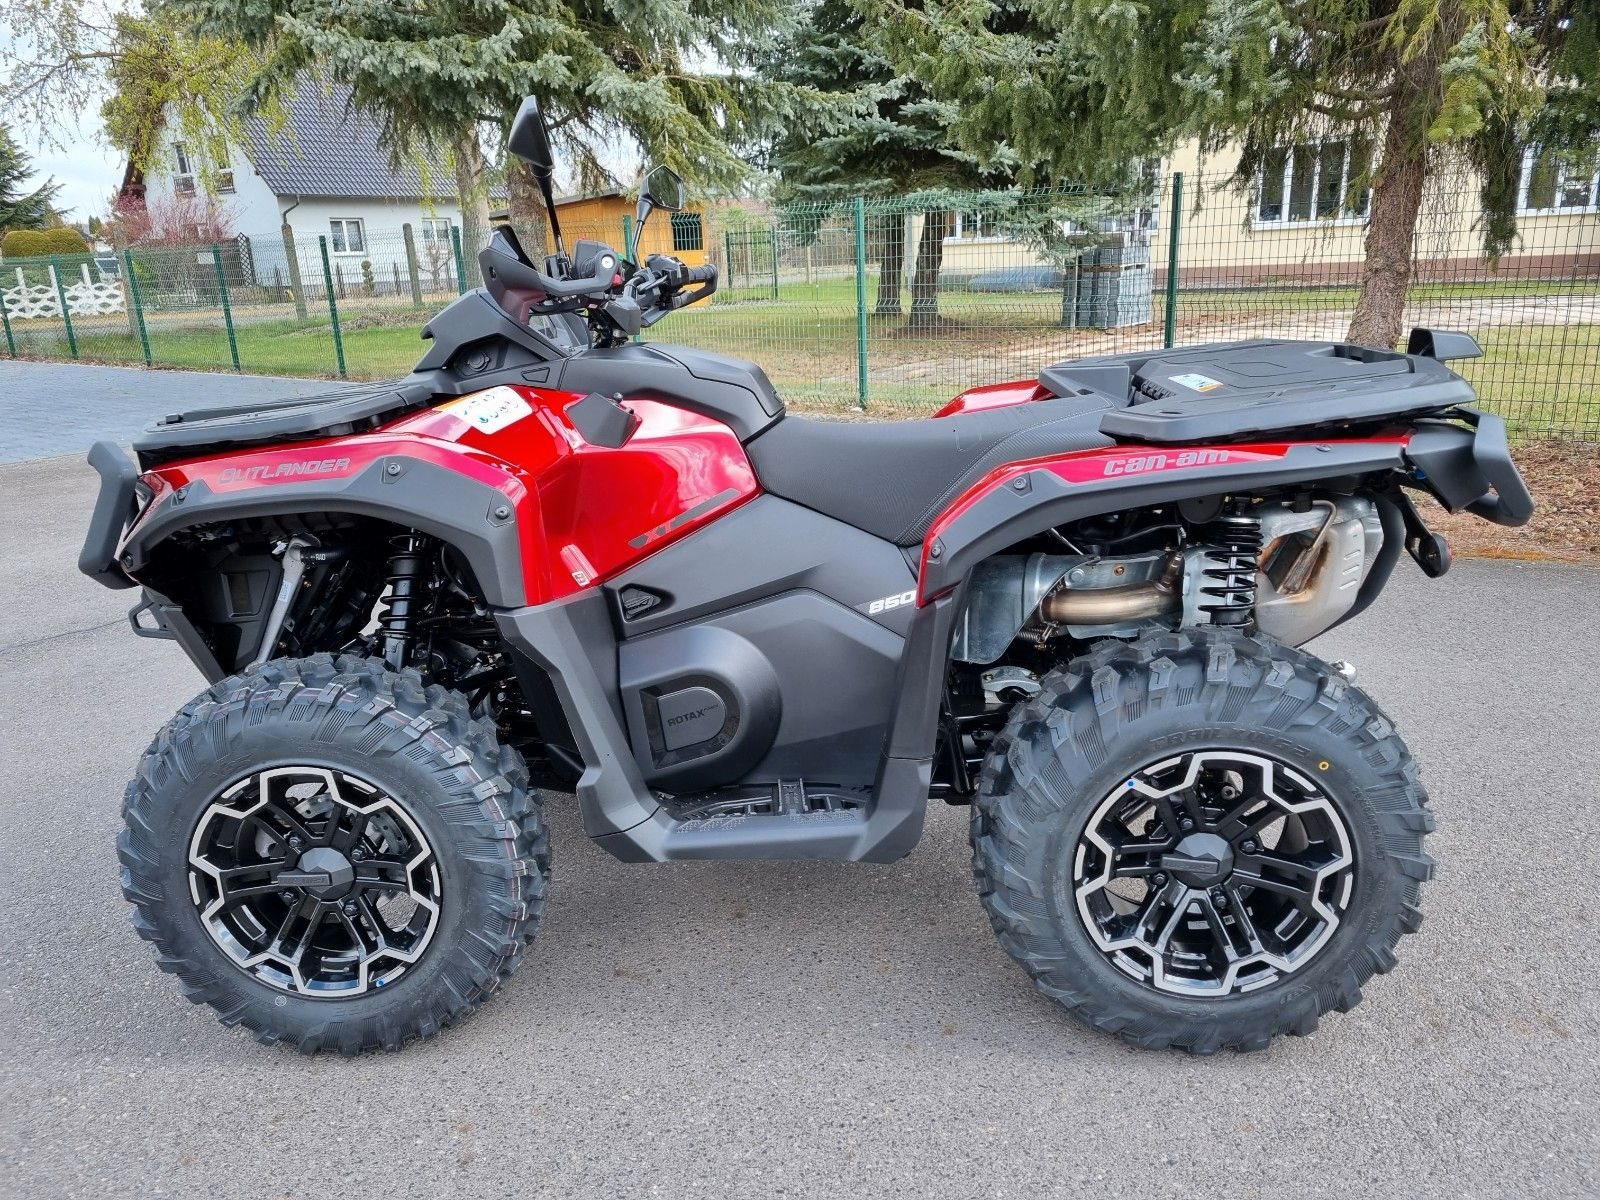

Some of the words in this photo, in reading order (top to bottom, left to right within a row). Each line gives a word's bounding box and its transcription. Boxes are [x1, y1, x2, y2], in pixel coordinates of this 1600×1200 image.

[218, 457, 351, 485] OUTLANDER
[1103, 450, 1229, 476] can-am
[868, 590, 917, 615] 850
[667, 709, 705, 727] ROTAX
